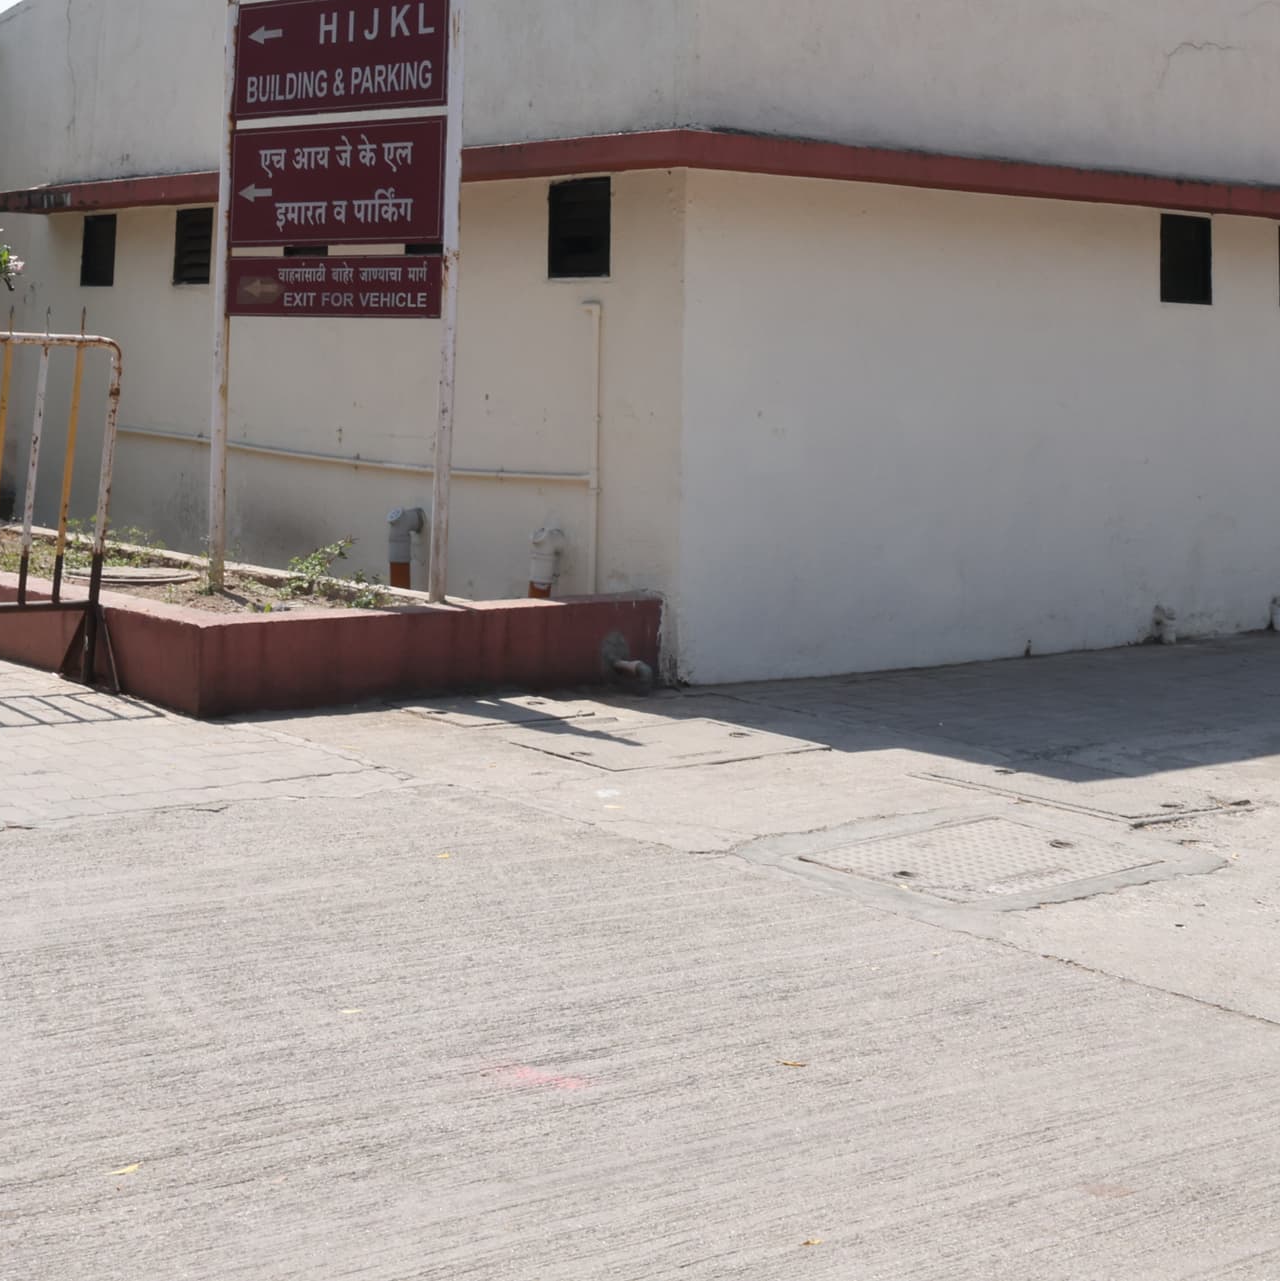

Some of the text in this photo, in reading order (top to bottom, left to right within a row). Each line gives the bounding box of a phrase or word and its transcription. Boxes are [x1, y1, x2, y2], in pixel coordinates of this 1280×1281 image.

[246, 60, 432, 104] BUILDING & PARKING
[259, 133, 413, 178] एच आय जे के एल
[275, 187, 413, 231] इमारत व पार्किंग
[278, 261, 326, 284] वाहनांसाठी
[359, 266, 402, 284] जाण्याचा
[408, 261, 428, 282] मार्ग
[283, 292, 427, 308] EXIT FOR VEHICLE
